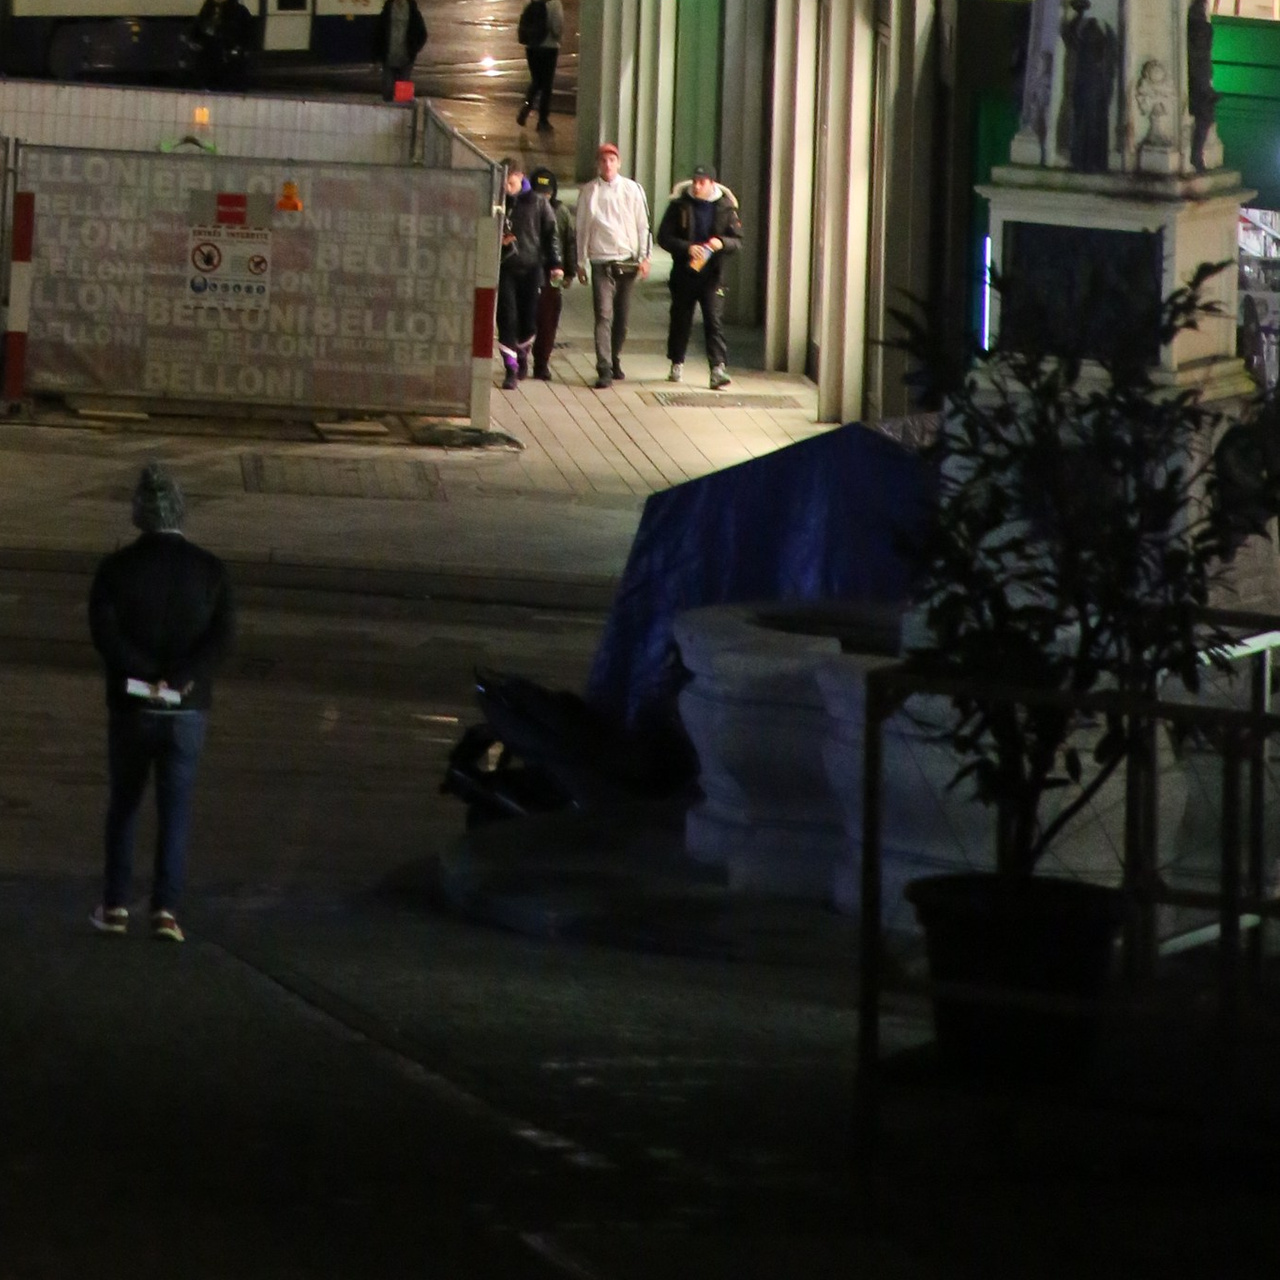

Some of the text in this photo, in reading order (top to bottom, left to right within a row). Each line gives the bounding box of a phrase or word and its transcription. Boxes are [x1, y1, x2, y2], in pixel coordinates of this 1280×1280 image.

[147, 296, 307, 334] BELLONI
[313, 305, 474, 343] BELLONI
[144, 360, 305, 399] BELLONI
